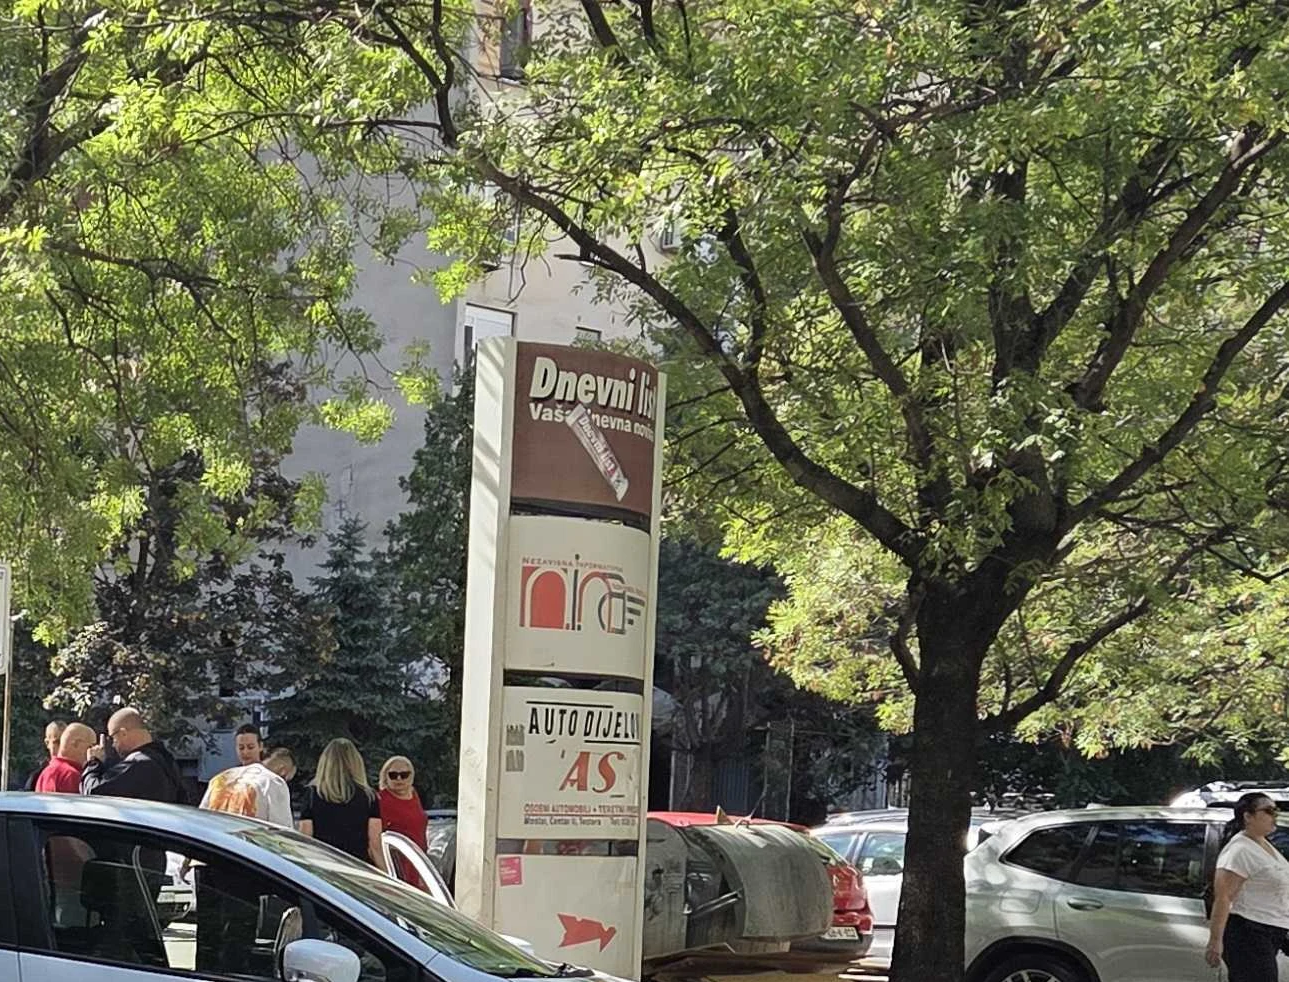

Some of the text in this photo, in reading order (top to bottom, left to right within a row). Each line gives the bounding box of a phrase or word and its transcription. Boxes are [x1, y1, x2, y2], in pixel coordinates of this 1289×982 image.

[529, 356, 635, 412] Dnevni
[587, 408, 631, 432] nevna
[528, 706, 579, 737] AUTO
[558, 751, 626, 793] AS
